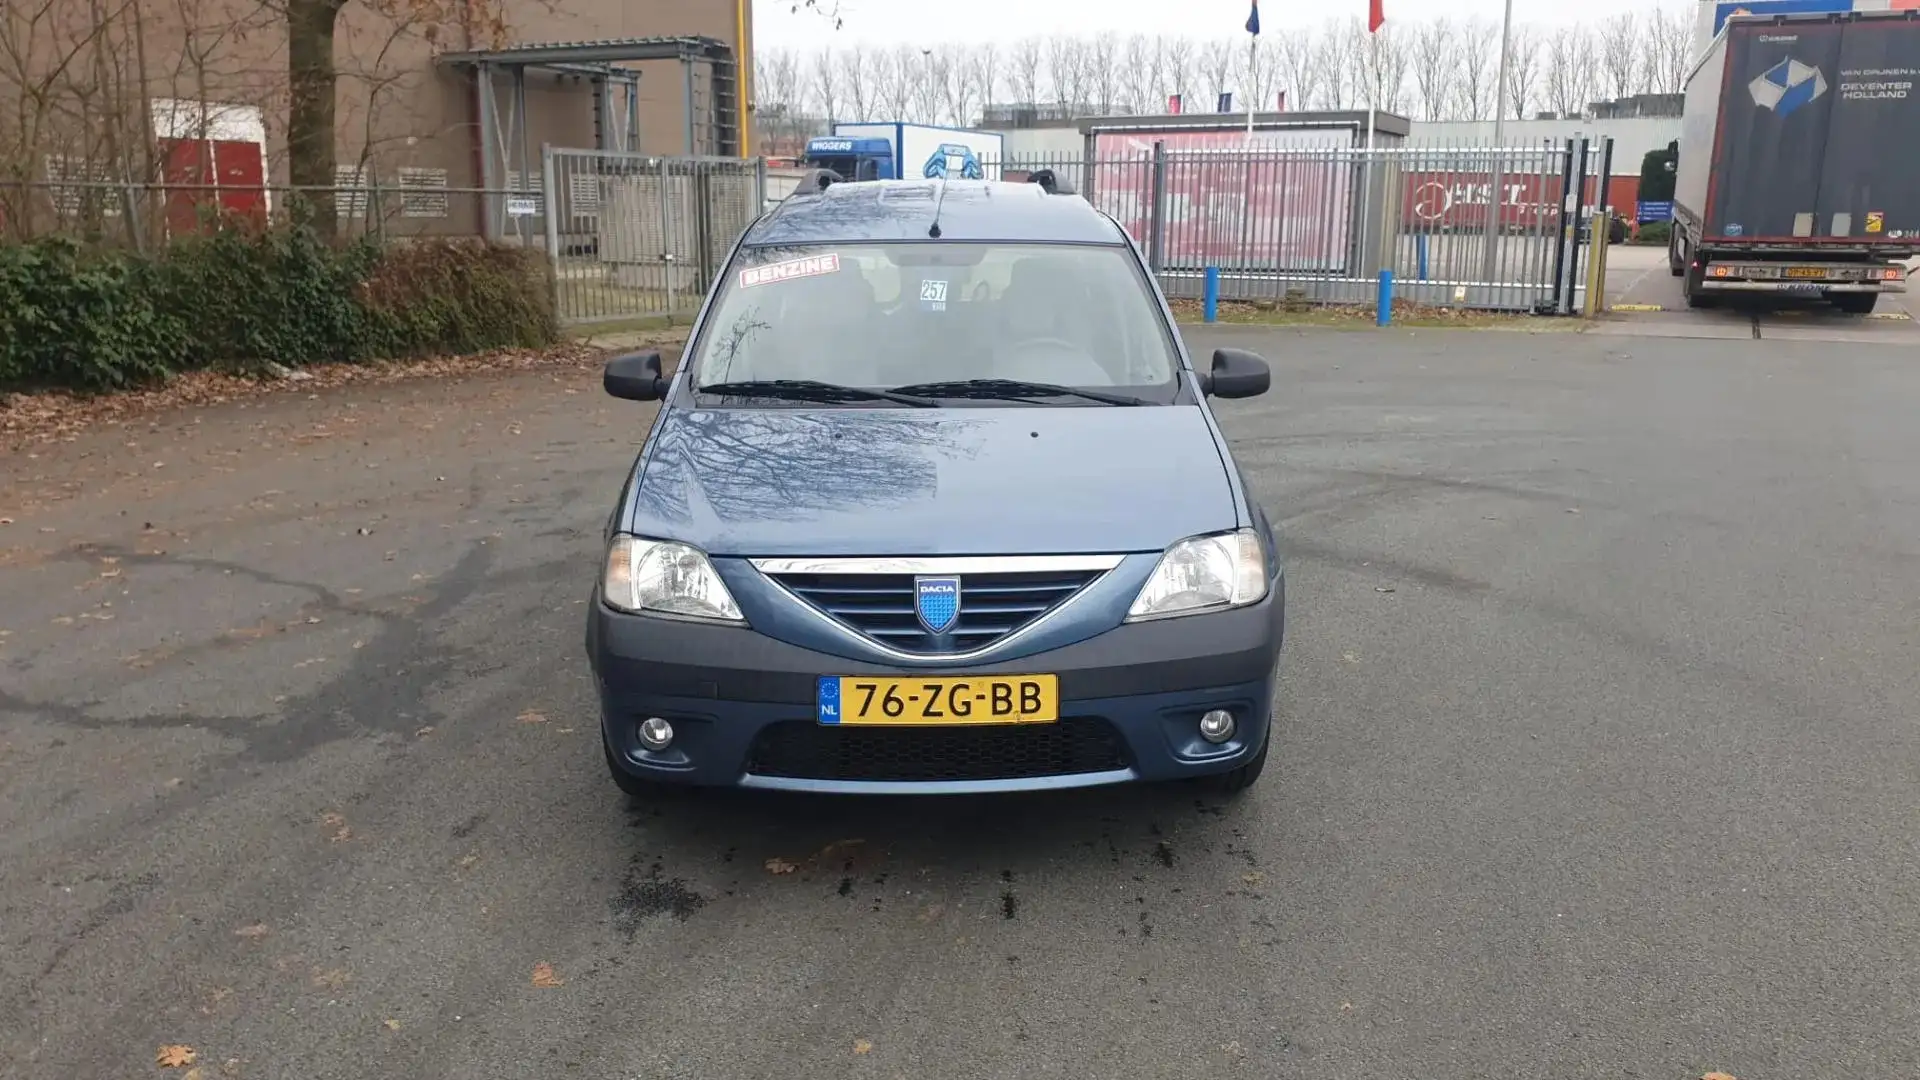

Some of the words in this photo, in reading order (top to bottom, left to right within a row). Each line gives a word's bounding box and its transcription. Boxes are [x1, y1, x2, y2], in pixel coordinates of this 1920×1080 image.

[1840, 81, 1913, 91] DEVENTER
[1842, 90, 1907, 99] HOLLAND
[811, 140, 852, 151] WIGGERS
[744, 256, 835, 285] BENZINE
[921, 280, 946, 299] 257
[919, 585, 955, 593] DACIA
[855, 682, 1042, 717] 76-ZG-BB
[821, 705, 838, 716] NL
